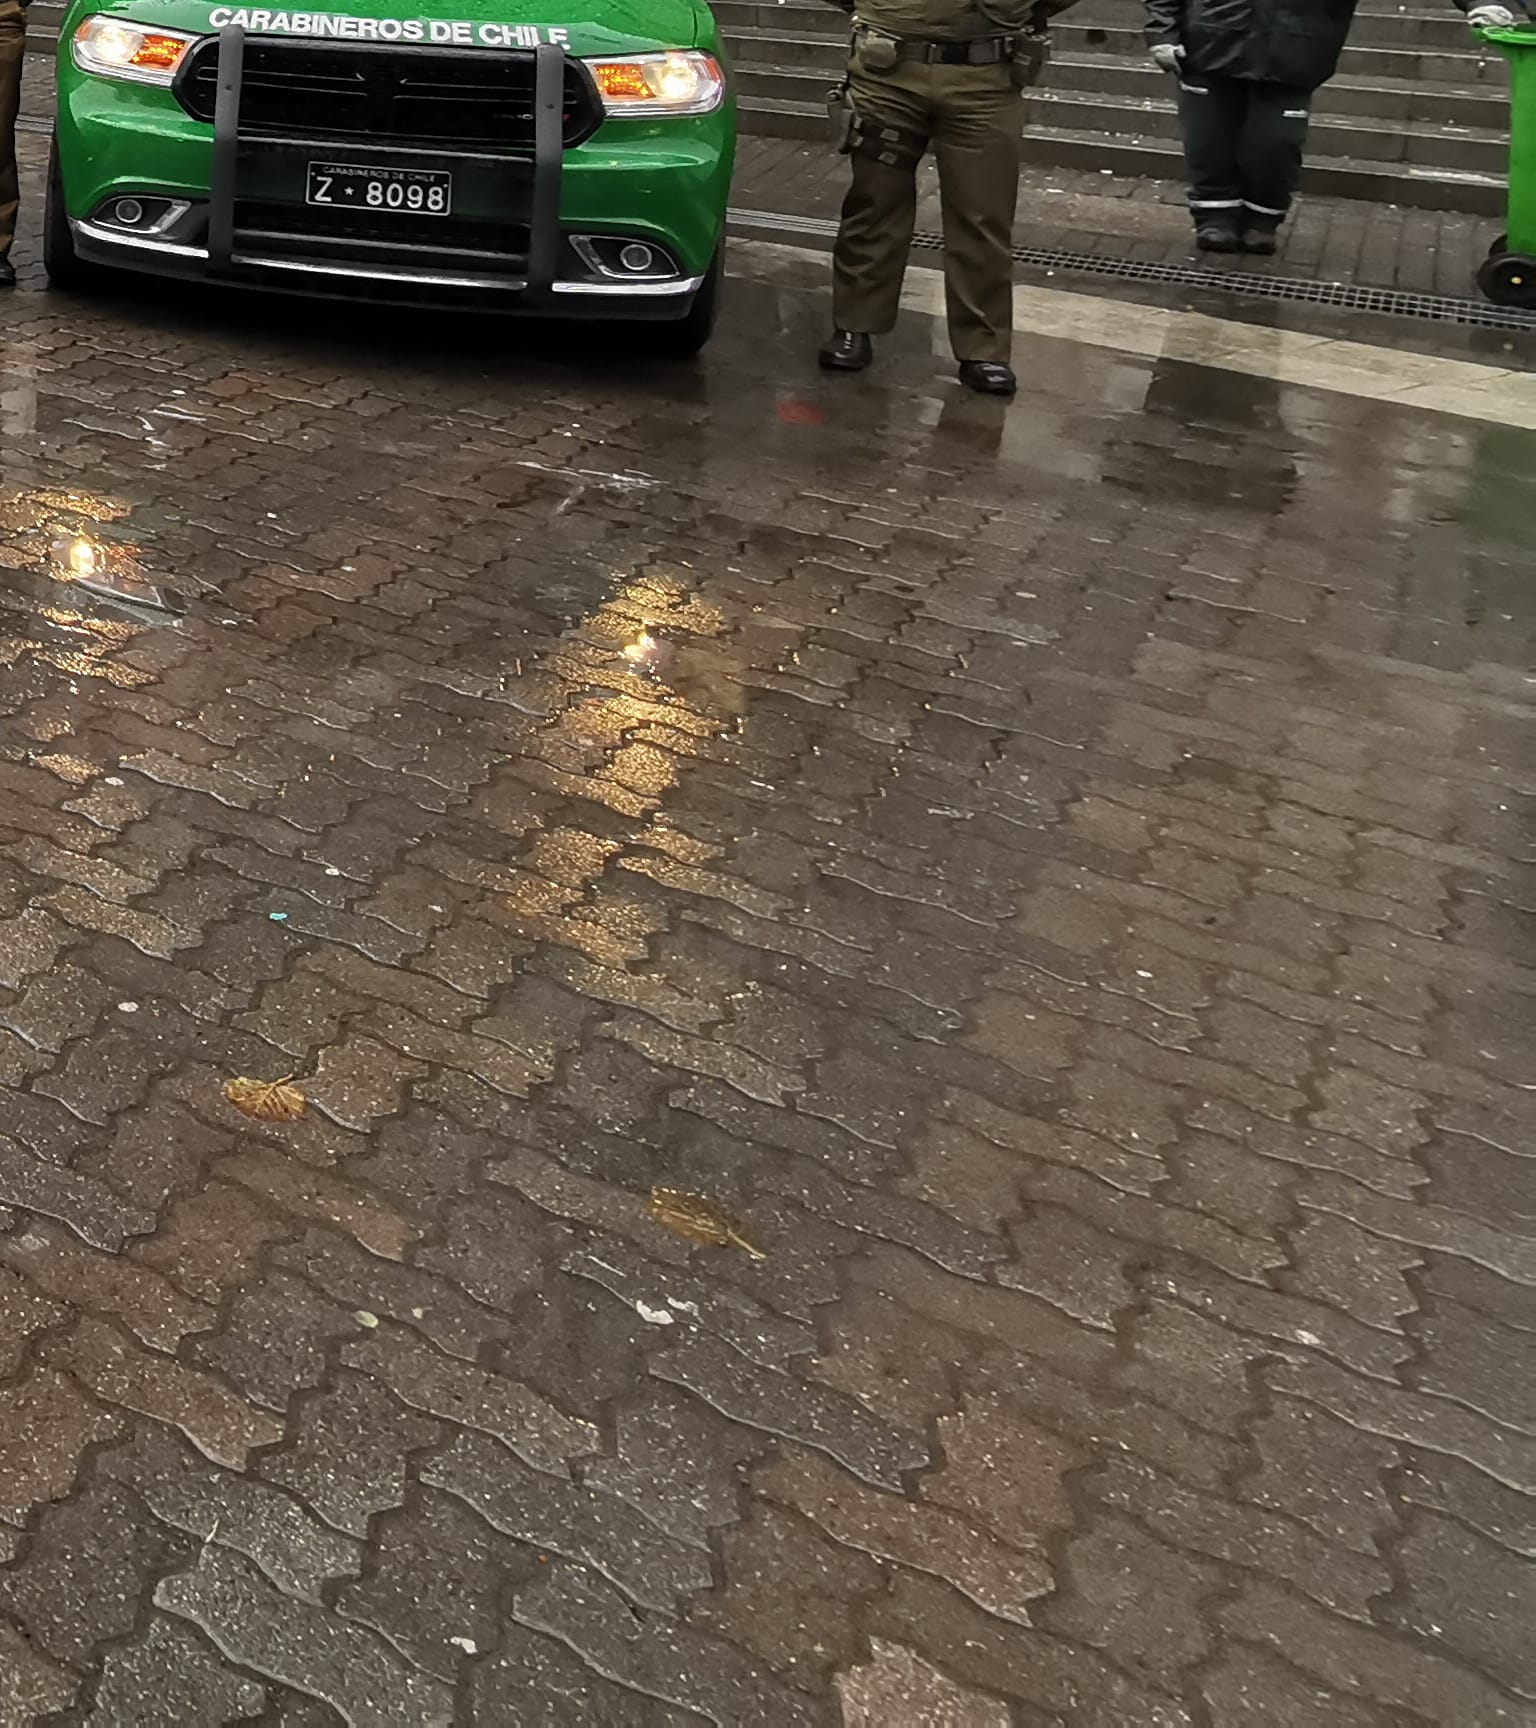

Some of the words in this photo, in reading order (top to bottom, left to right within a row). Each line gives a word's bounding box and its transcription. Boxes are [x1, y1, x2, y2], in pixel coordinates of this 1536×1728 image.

[208, 7, 425, 42] CARABINEROS
[429, 21, 474, 45] DE
[477, 23, 572, 51] CHILE
[322, 166, 390, 180] CARABINEROS
[391, 172, 404, 181] DE
[407, 173, 435, 183] CHILE
[314, 175, 333, 202] Z
[365, 181, 445, 211] 8098
